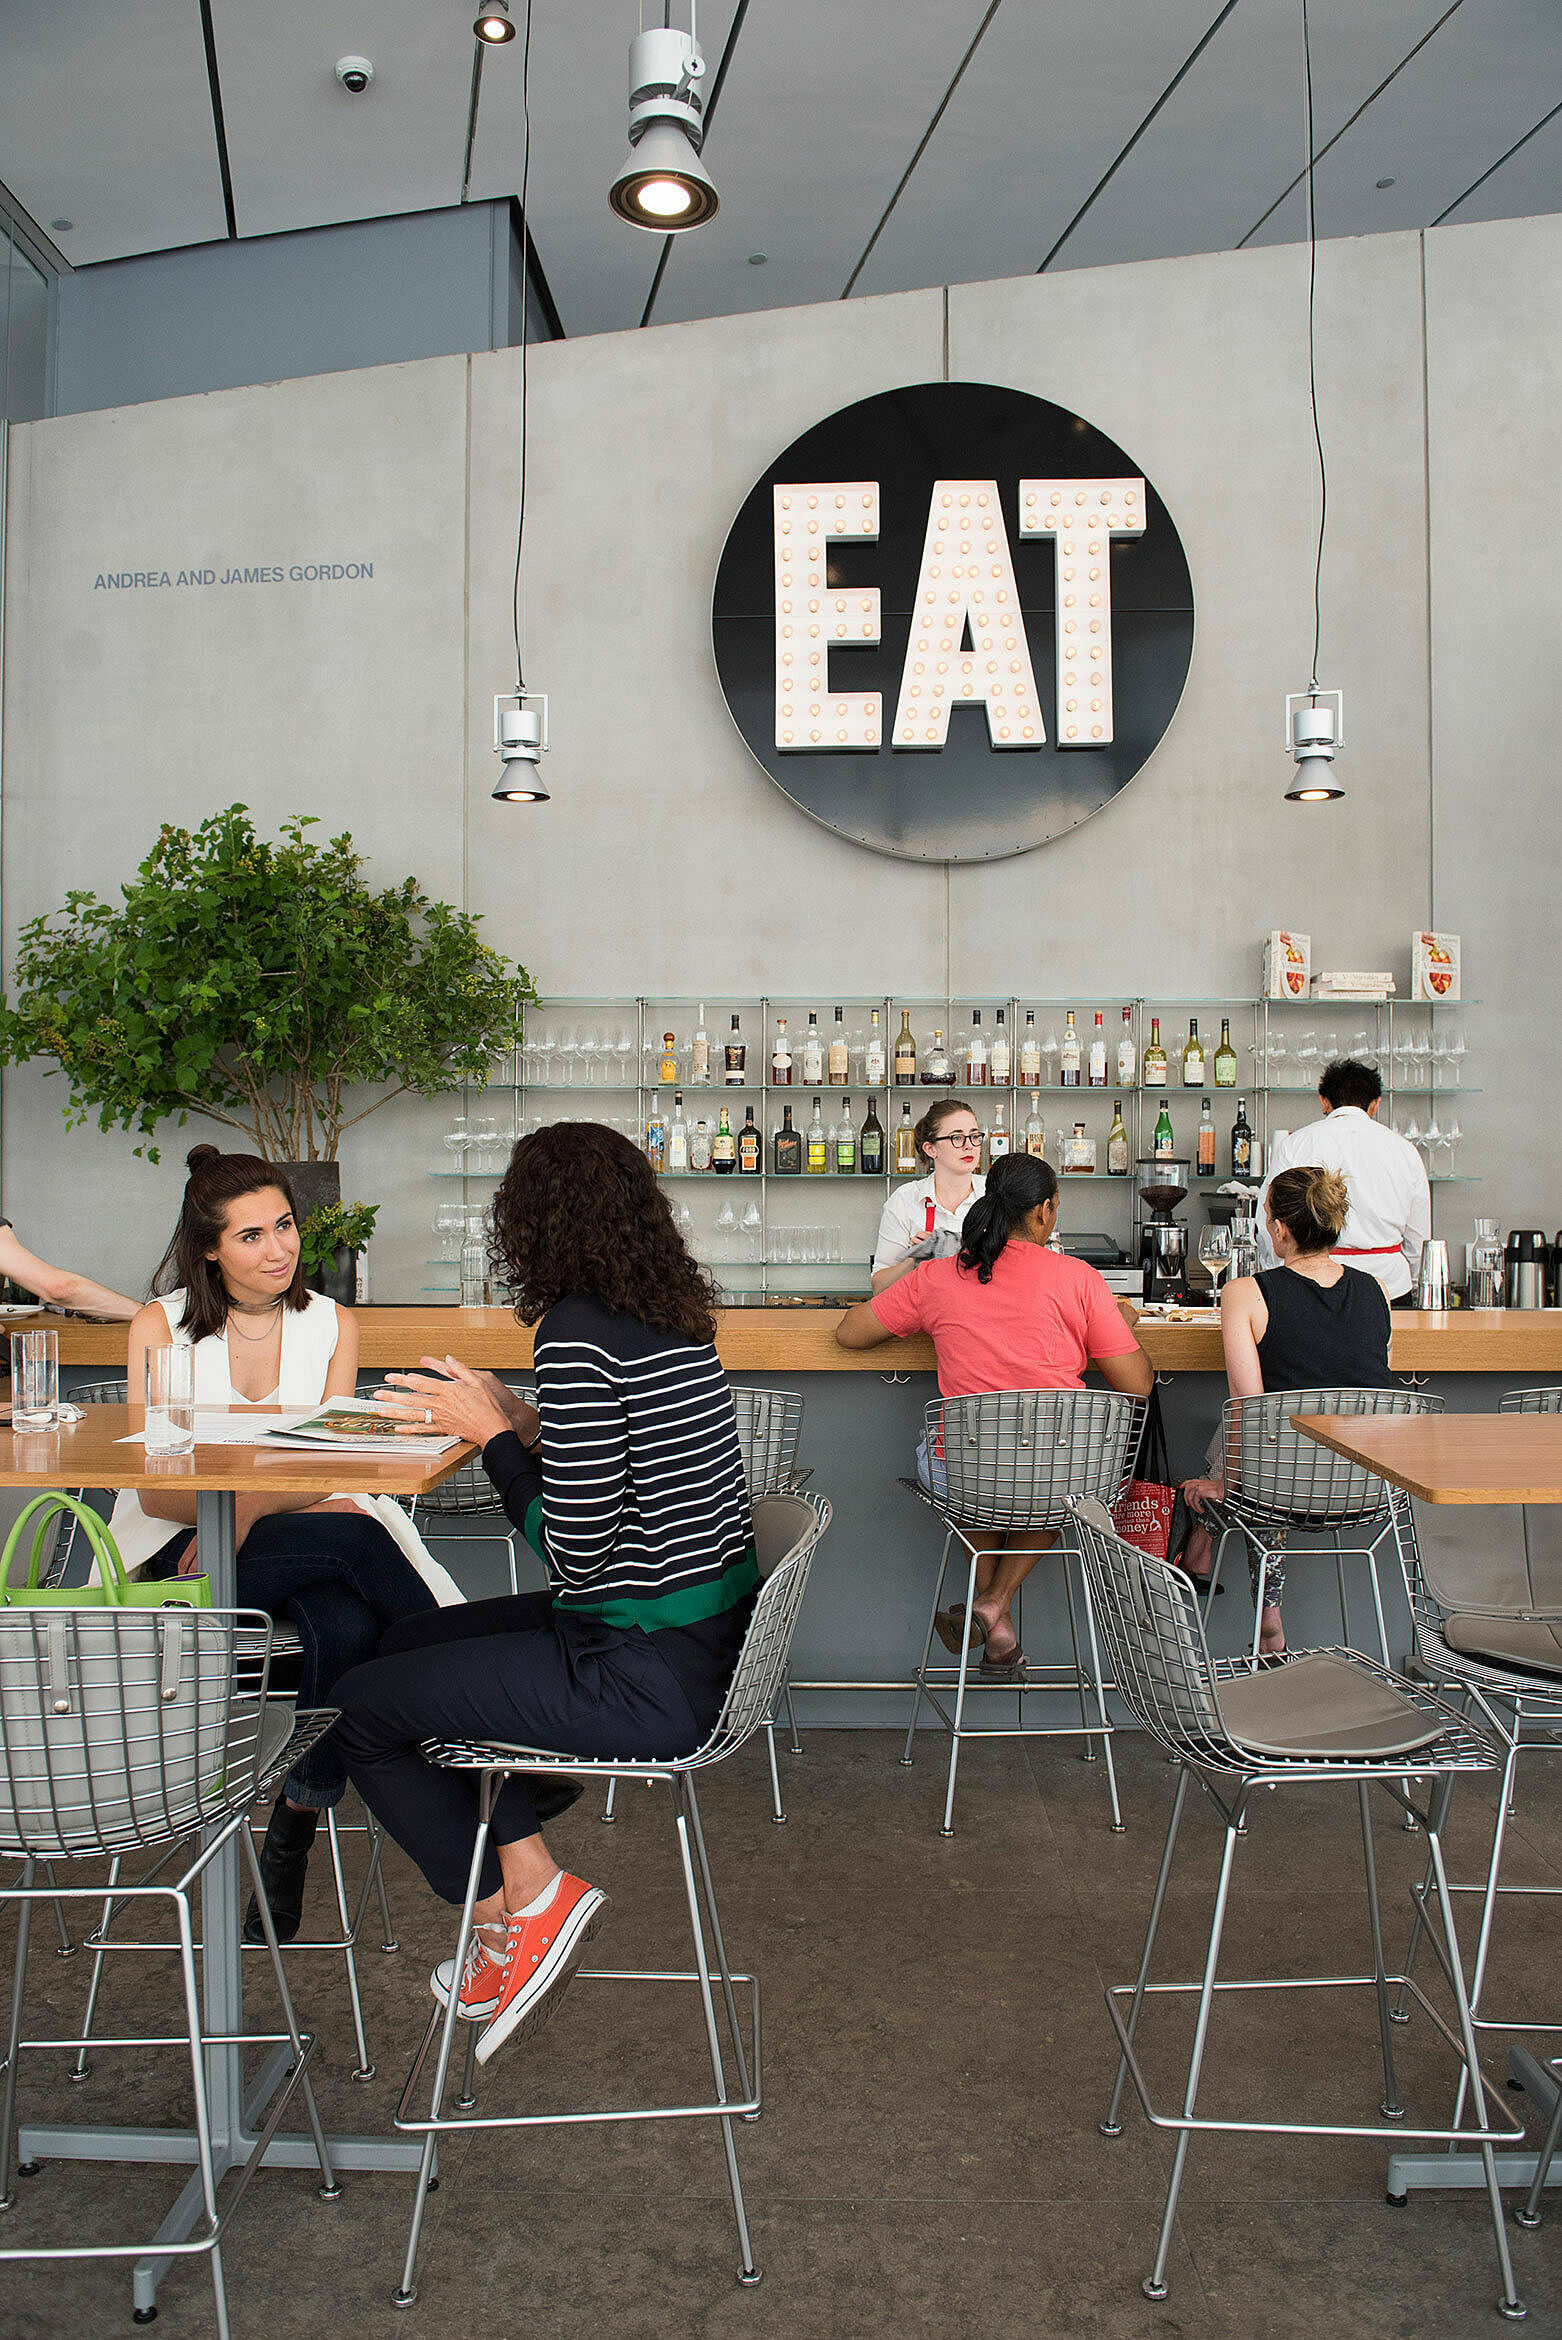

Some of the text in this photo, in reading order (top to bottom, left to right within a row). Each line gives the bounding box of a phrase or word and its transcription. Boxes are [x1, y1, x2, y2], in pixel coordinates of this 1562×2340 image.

[94, 562, 374, 590] ANDREA AND JAMES GORDON
[773, 477, 1147, 750] EAT
[1126, 1510, 1151, 1518] more
